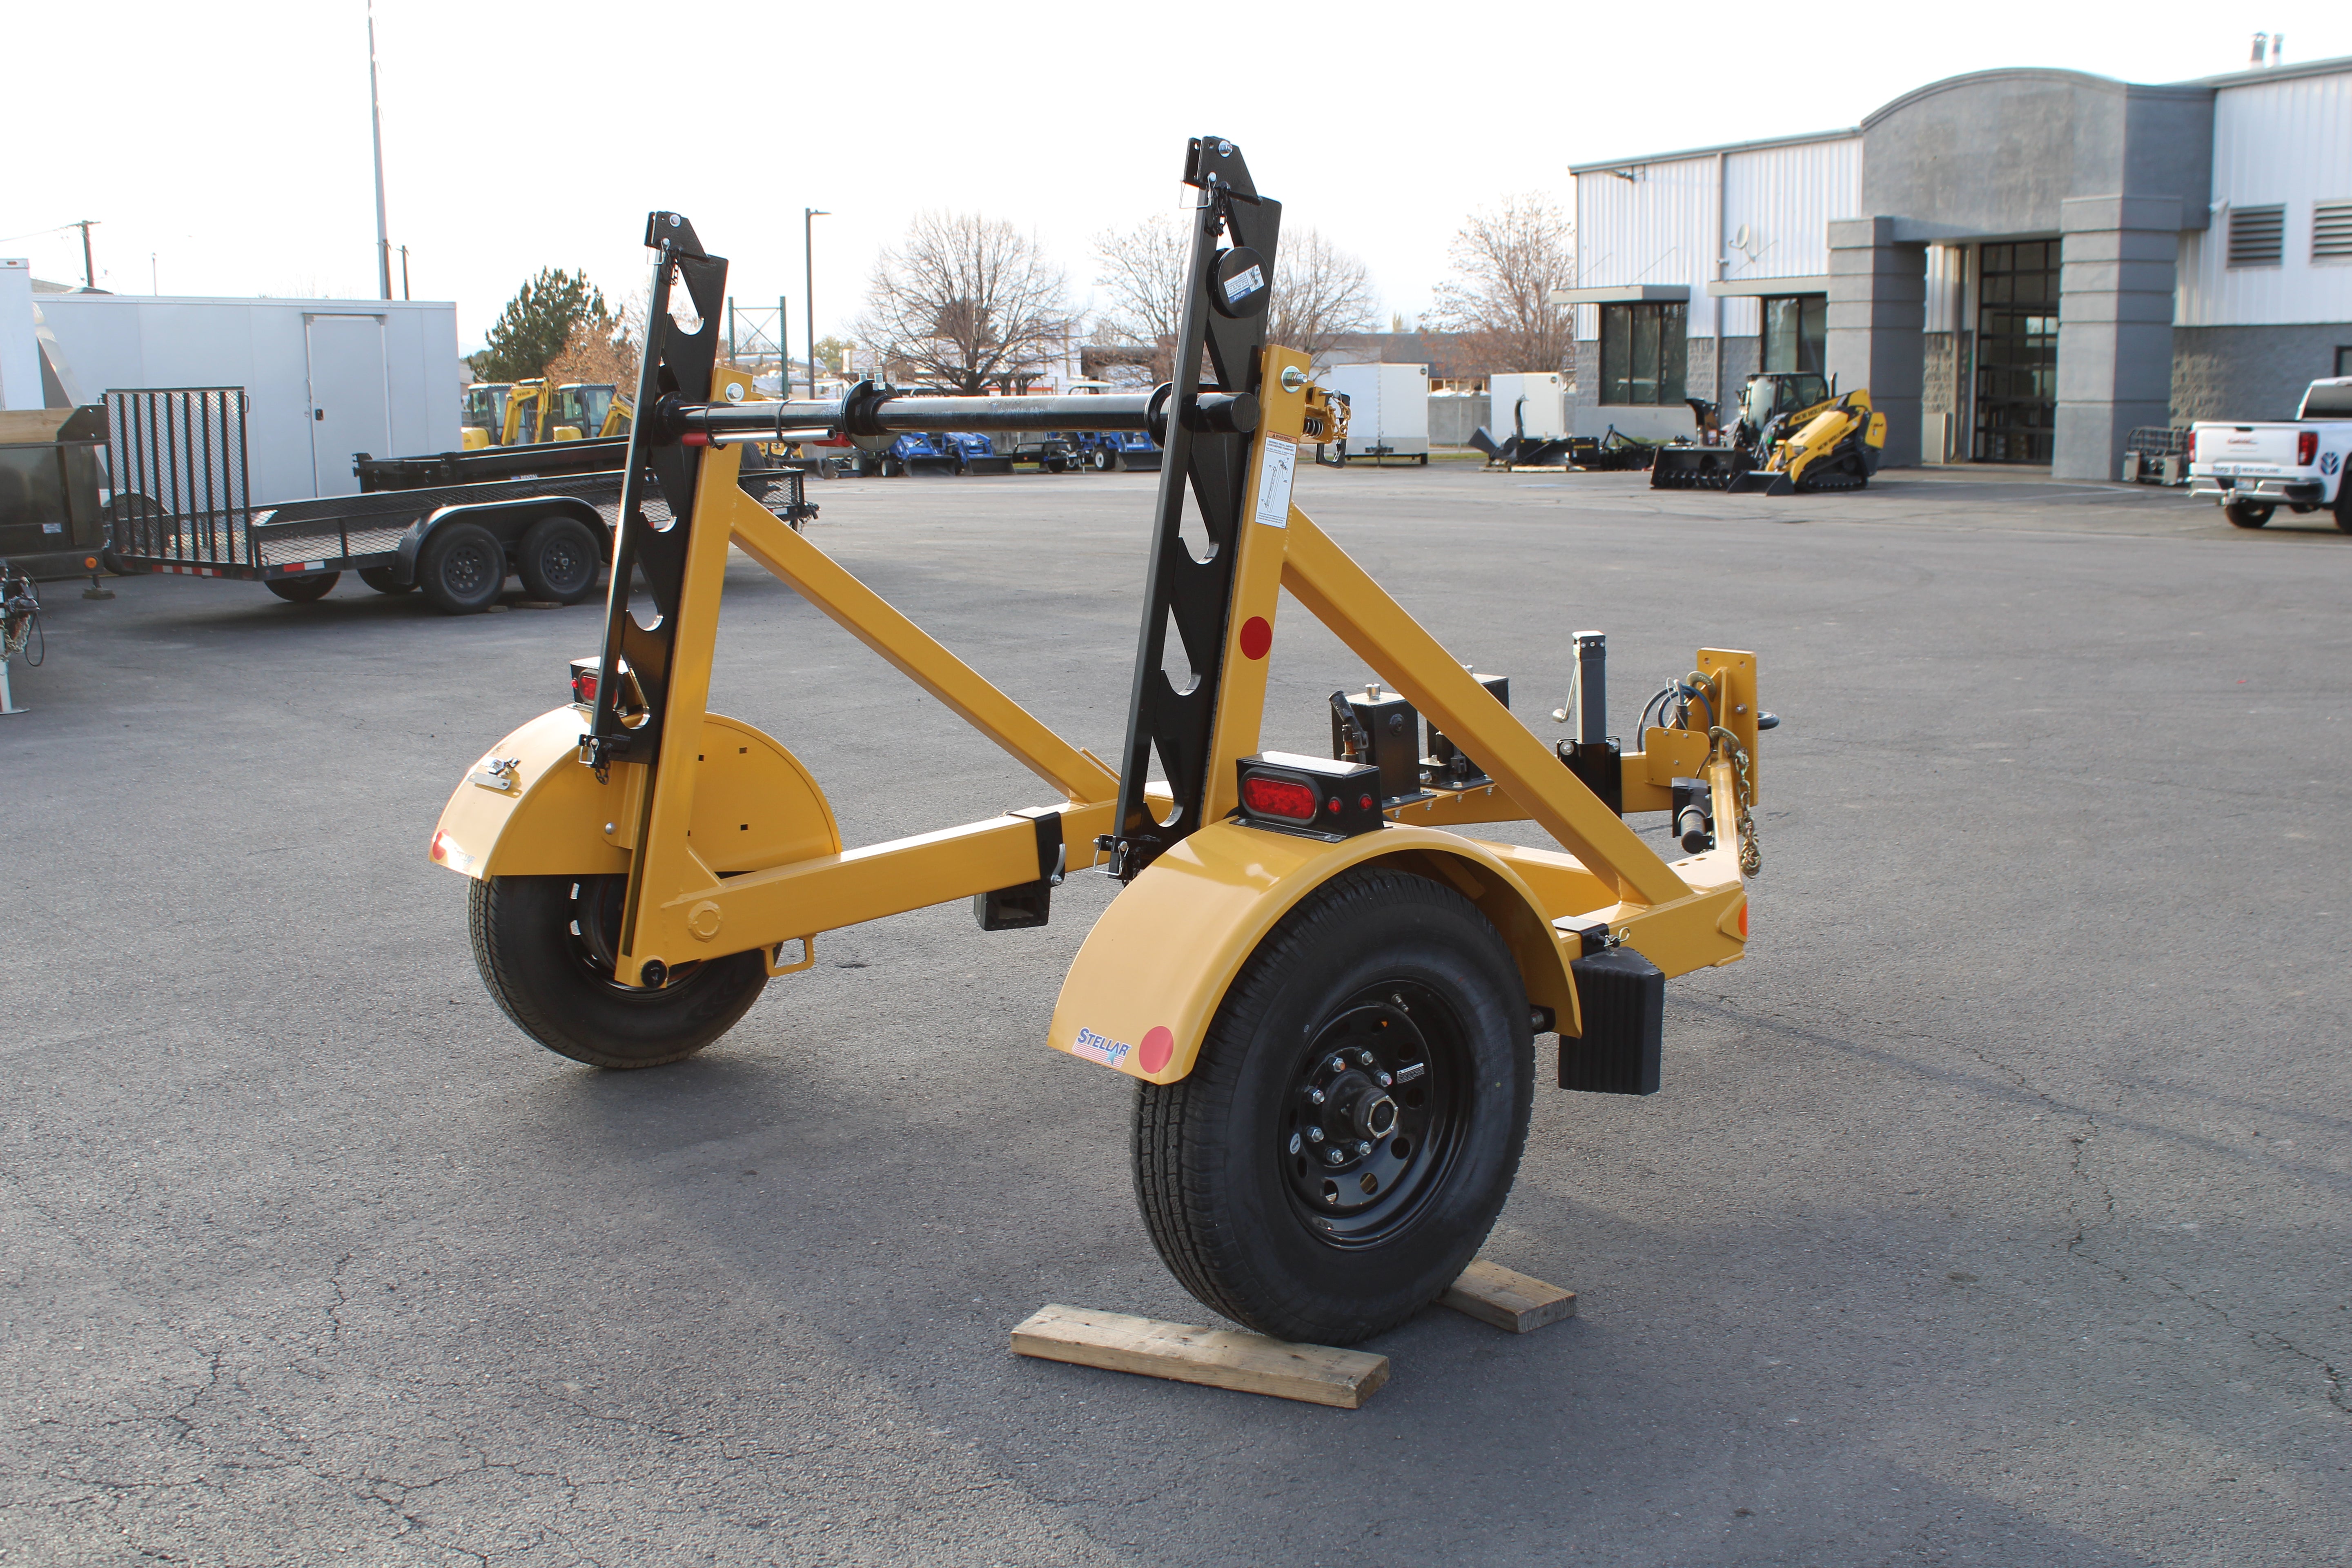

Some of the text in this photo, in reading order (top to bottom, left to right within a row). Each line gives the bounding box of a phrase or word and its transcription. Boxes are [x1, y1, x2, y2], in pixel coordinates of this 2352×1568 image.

[1234, 290, 1246, 301] NOTICE
[1794, 403, 1833, 421] NEW HOLLAND
[1817, 427, 1850, 451] NEW HOLLAND
